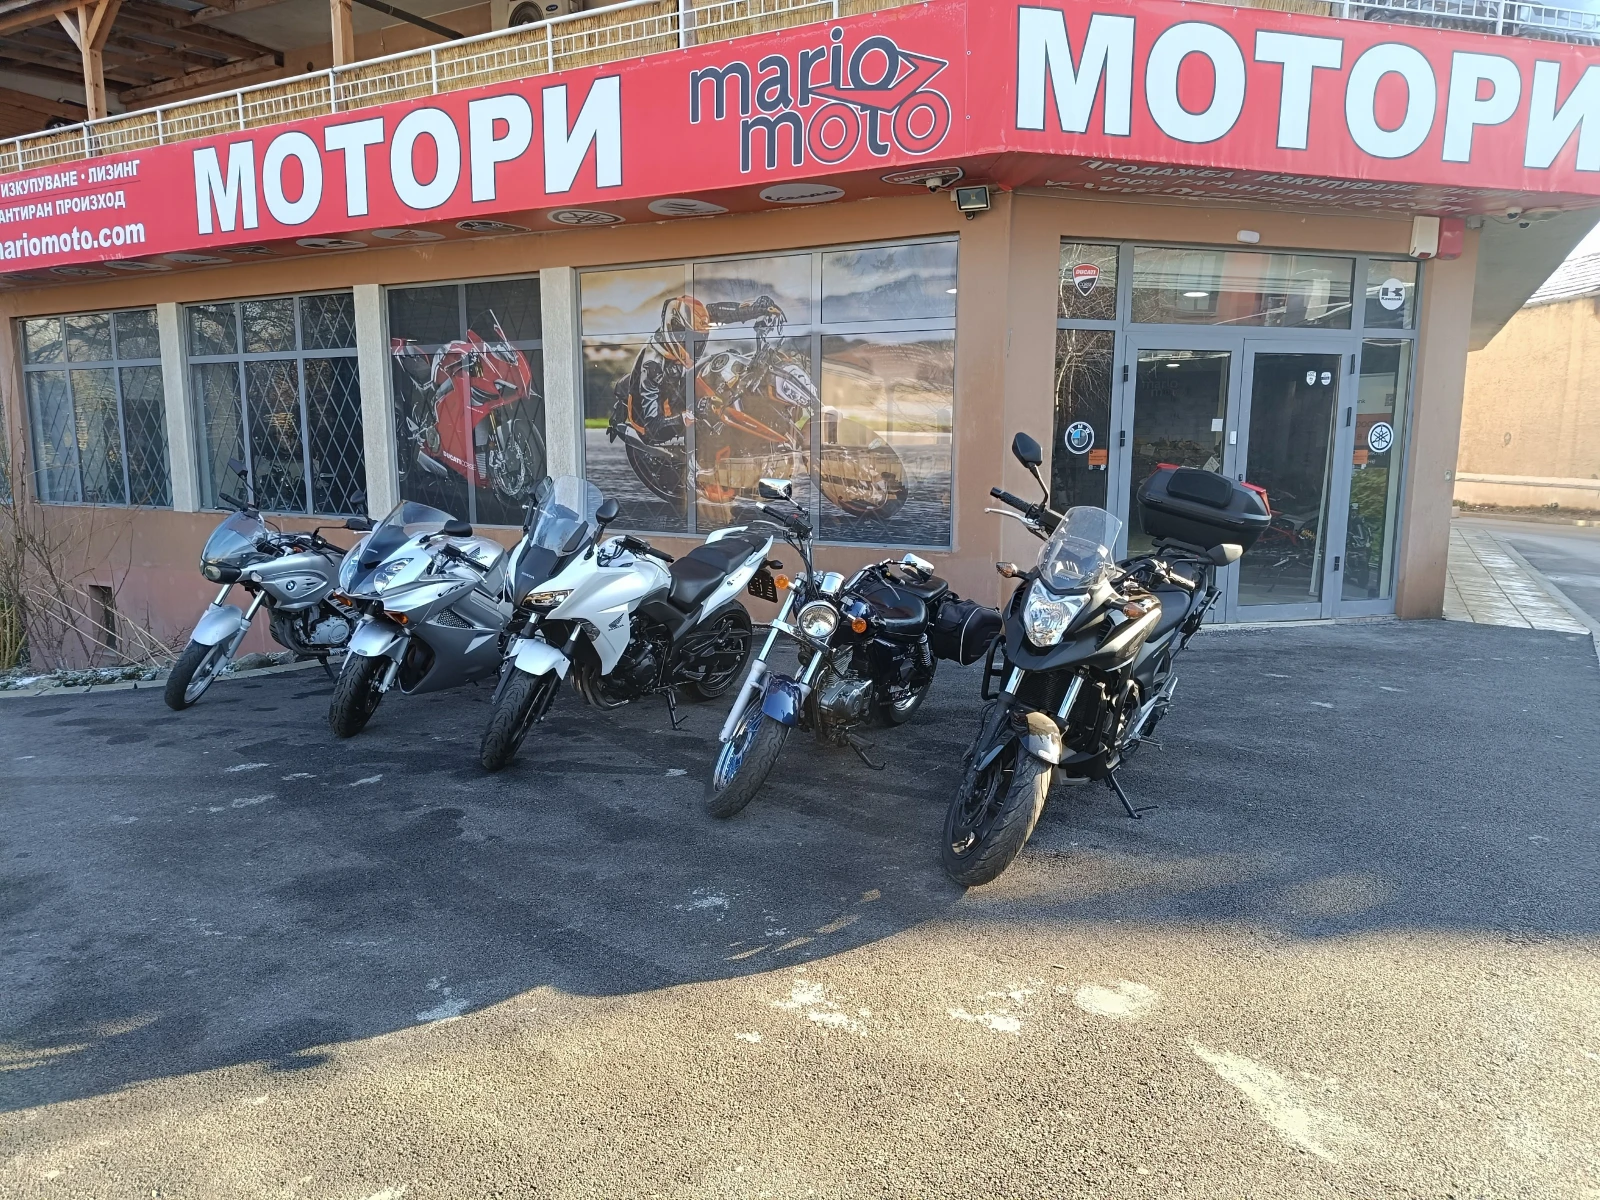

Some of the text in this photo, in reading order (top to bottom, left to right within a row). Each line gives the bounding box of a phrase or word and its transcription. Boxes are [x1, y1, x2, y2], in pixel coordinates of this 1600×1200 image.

[690, 26, 900, 124] mario
[1015, 3, 1600, 174] МОТОРИ
[192, 74, 622, 236] МОТОРИ
[740, 90, 951, 173] moto
[0, 160, 140, 198] ИЗКУПУВАНЕ ЛИЗИНГ
[55, 190, 126, 215] ПРОИЗХОД
[1254, 173, 1424, 192] ИЗКУПУВАНЕ
